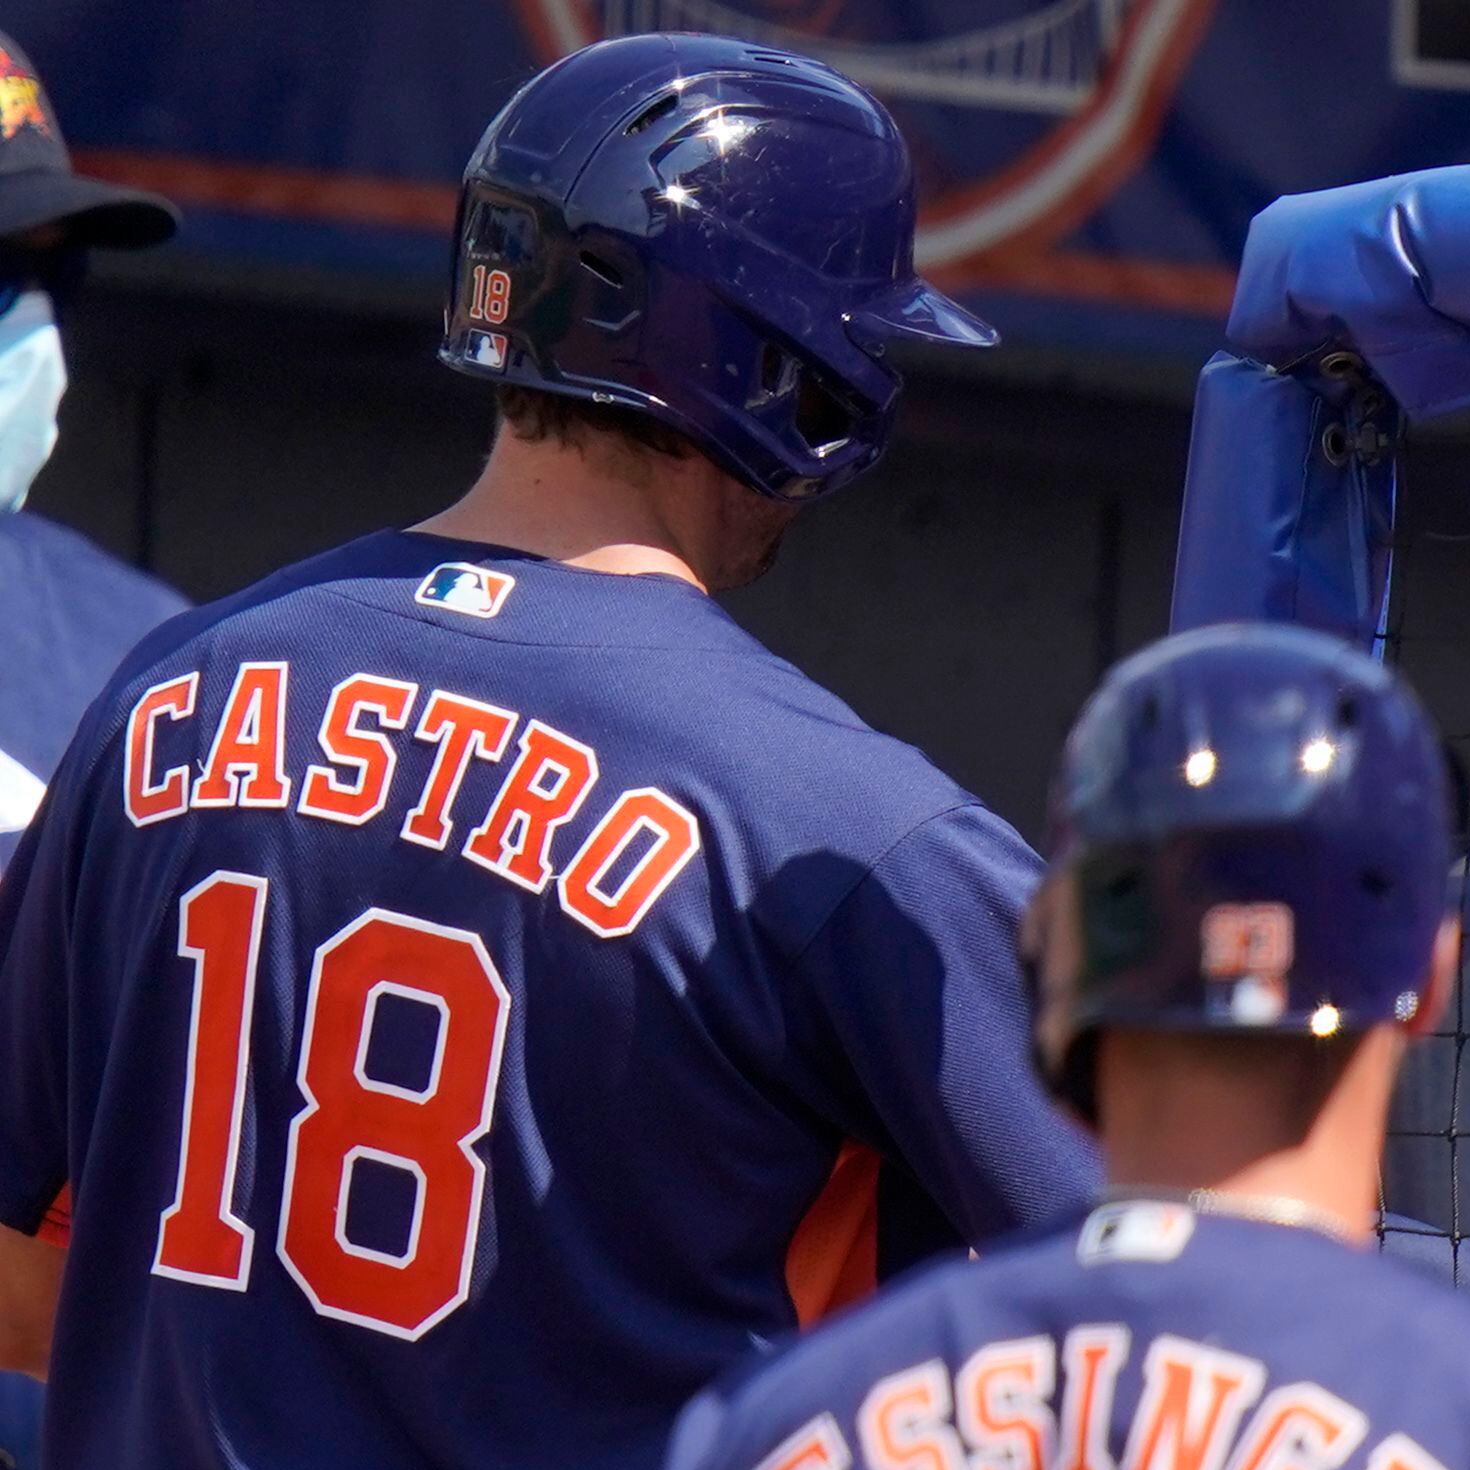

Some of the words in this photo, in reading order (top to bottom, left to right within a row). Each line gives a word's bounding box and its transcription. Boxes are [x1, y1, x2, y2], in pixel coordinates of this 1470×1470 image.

[469, 264, 511, 325] 18
[124, 661, 701, 939] CASTRO
[151, 869, 512, 1342] 18
